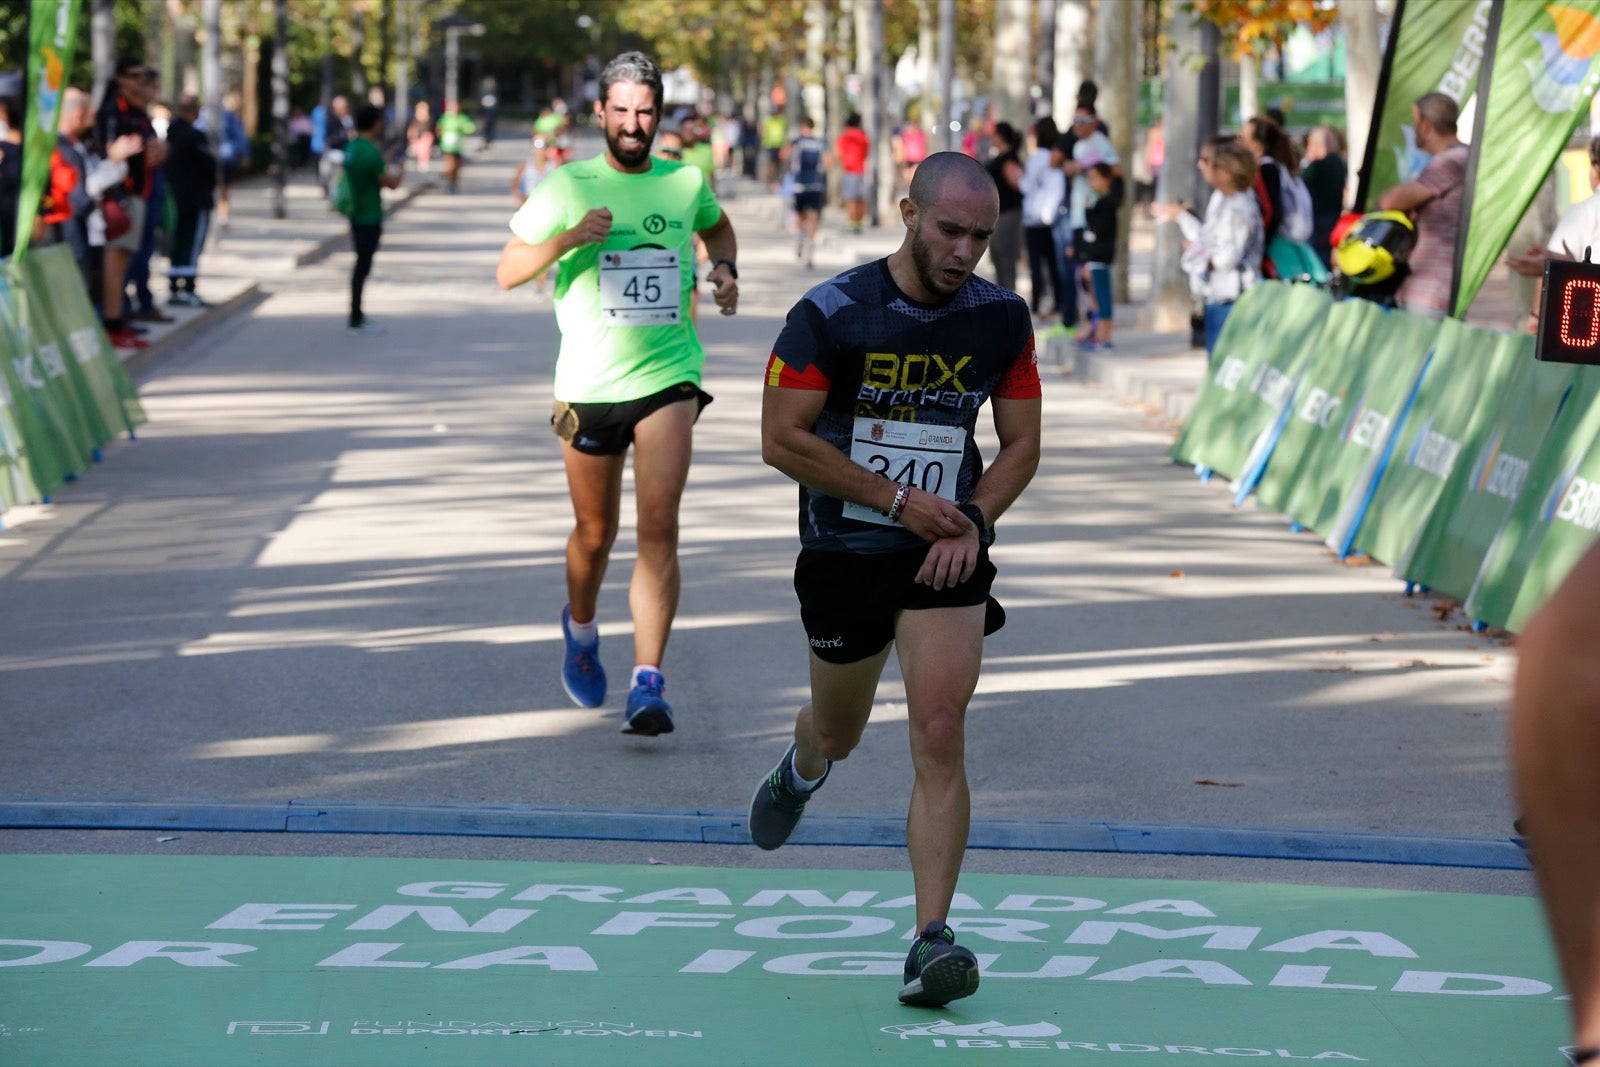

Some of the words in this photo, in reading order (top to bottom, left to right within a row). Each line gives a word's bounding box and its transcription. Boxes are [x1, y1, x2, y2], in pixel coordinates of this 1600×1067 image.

[623, 275, 662, 303] 45
[1560, 279, 1600, 347] 0
[862, 352, 973, 393] BOX
[867, 454, 944, 499] 340
[396, 880, 1217, 918] GRANADA
[204, 902, 540, 934] EN
[590, 910, 1420, 959] FORMA
[0, 938, 258, 967] OR
[315, 942, 599, 972] LA
[678, 949, 1573, 999] IGUALD
[350, 1028, 541, 1036] DEPORTE
[554, 1029, 703, 1038] JOVEN
[932, 1039, 1368, 1061] IBERDROLA
